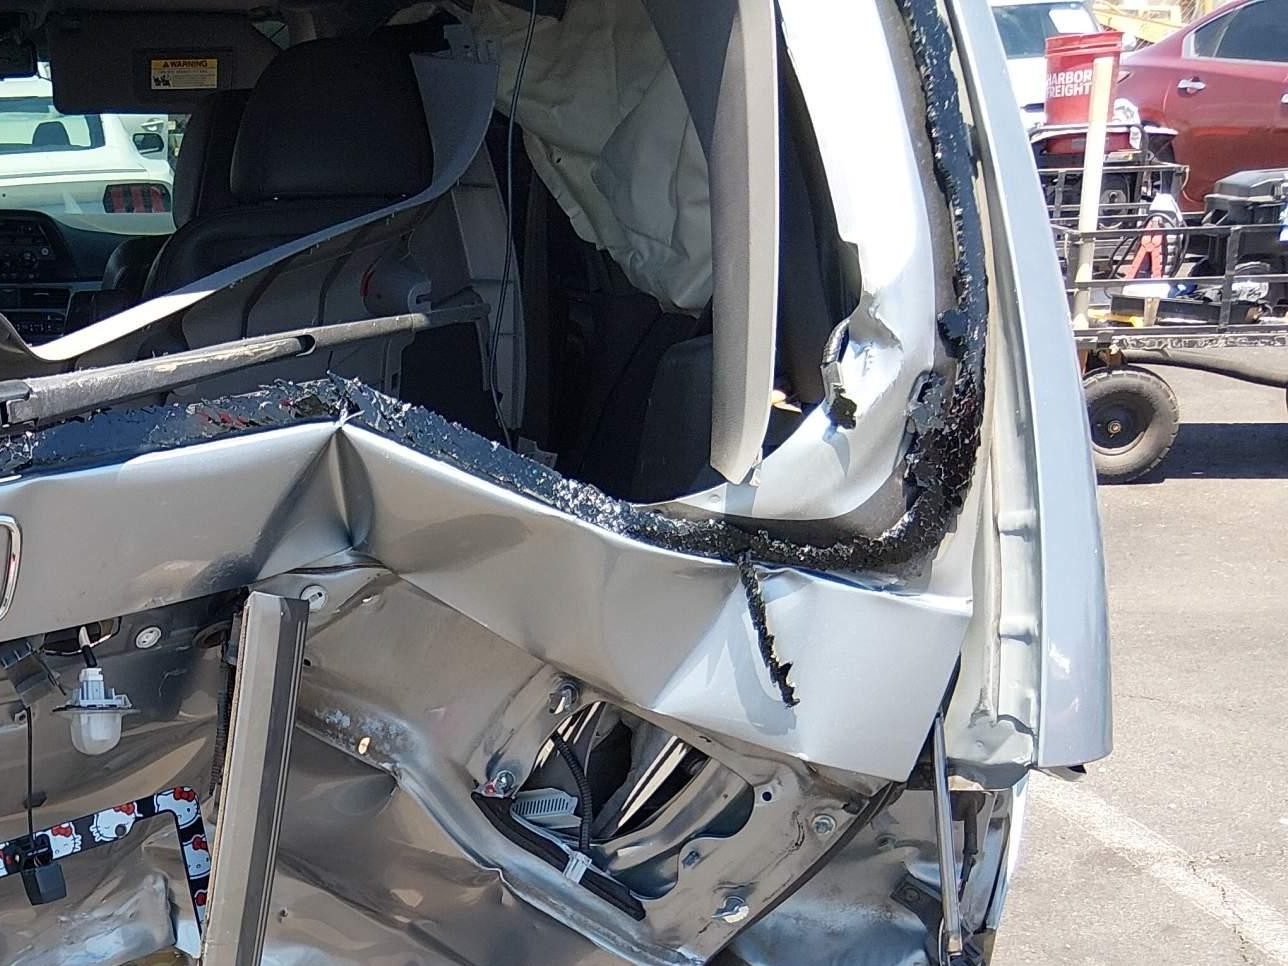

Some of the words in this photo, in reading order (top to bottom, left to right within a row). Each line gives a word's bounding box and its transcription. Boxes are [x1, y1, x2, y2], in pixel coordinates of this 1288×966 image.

[171, 60, 208, 69] WARNING
[1047, 69, 1093, 85] HARBOR
[1047, 82, 1093, 98] FREIGHT
